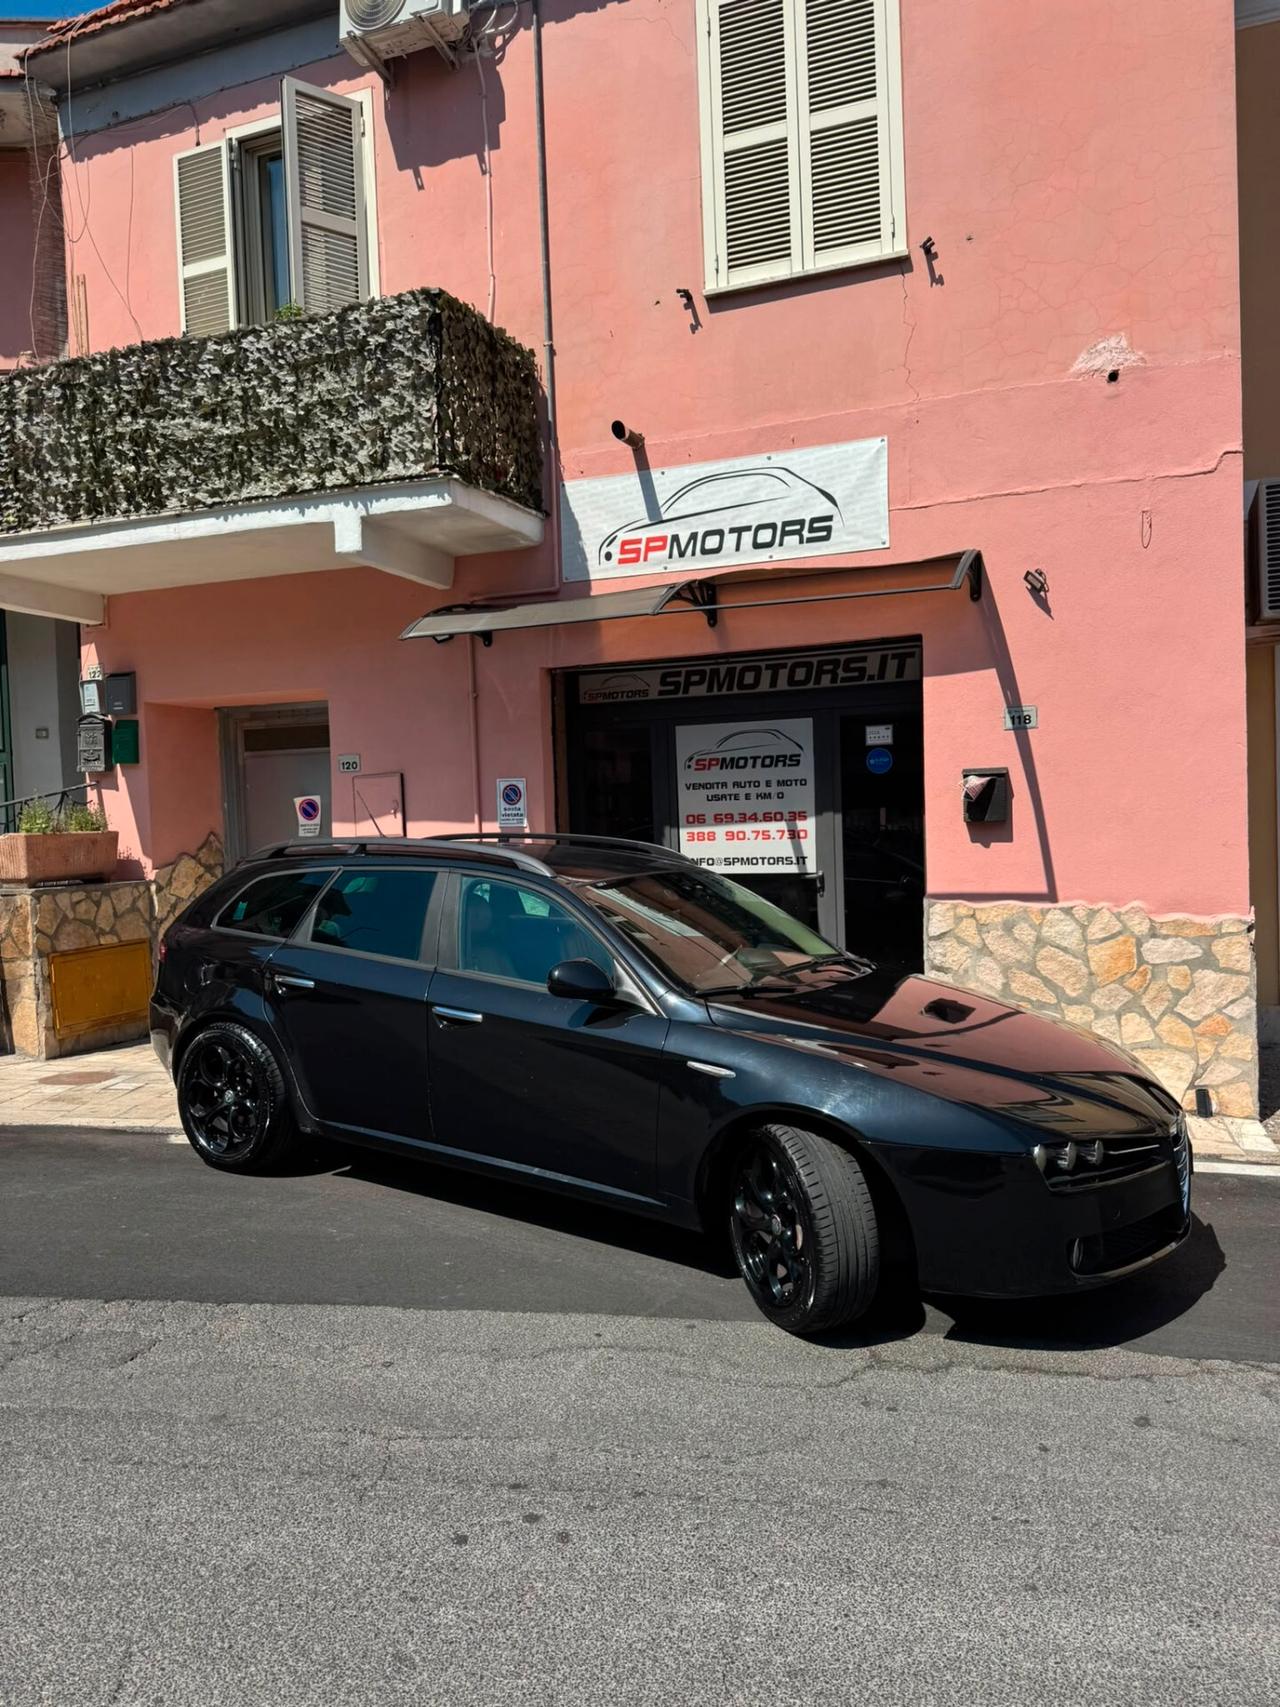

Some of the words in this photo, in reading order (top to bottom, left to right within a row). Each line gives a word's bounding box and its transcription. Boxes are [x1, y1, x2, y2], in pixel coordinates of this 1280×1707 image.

[617, 515, 834, 565] SPMOTORS
[658, 651, 916, 696] SPMOTORS.IT
[587, 688, 649, 702] SPMOTORS
[1010, 714, 1032, 725] 118
[342, 761, 358, 770] 120
[693, 753, 801, 772] SPMOTORS
[684, 780, 728, 791] VENDITA
[732, 780, 761, 789] AUTO
[766, 779, 772, 788] E
[776, 778, 807, 788] MOTO
[706, 793, 740, 802] USATE
[745, 792, 751, 801] E
[685, 813, 706, 824] 06
[713, 811, 808, 824] 69.34.60.35
[686, 831, 716, 842] 388
[725, 829, 808, 841] 90.75.730
[690, 856, 808, 867] NFO@SPMOTORS.IT
